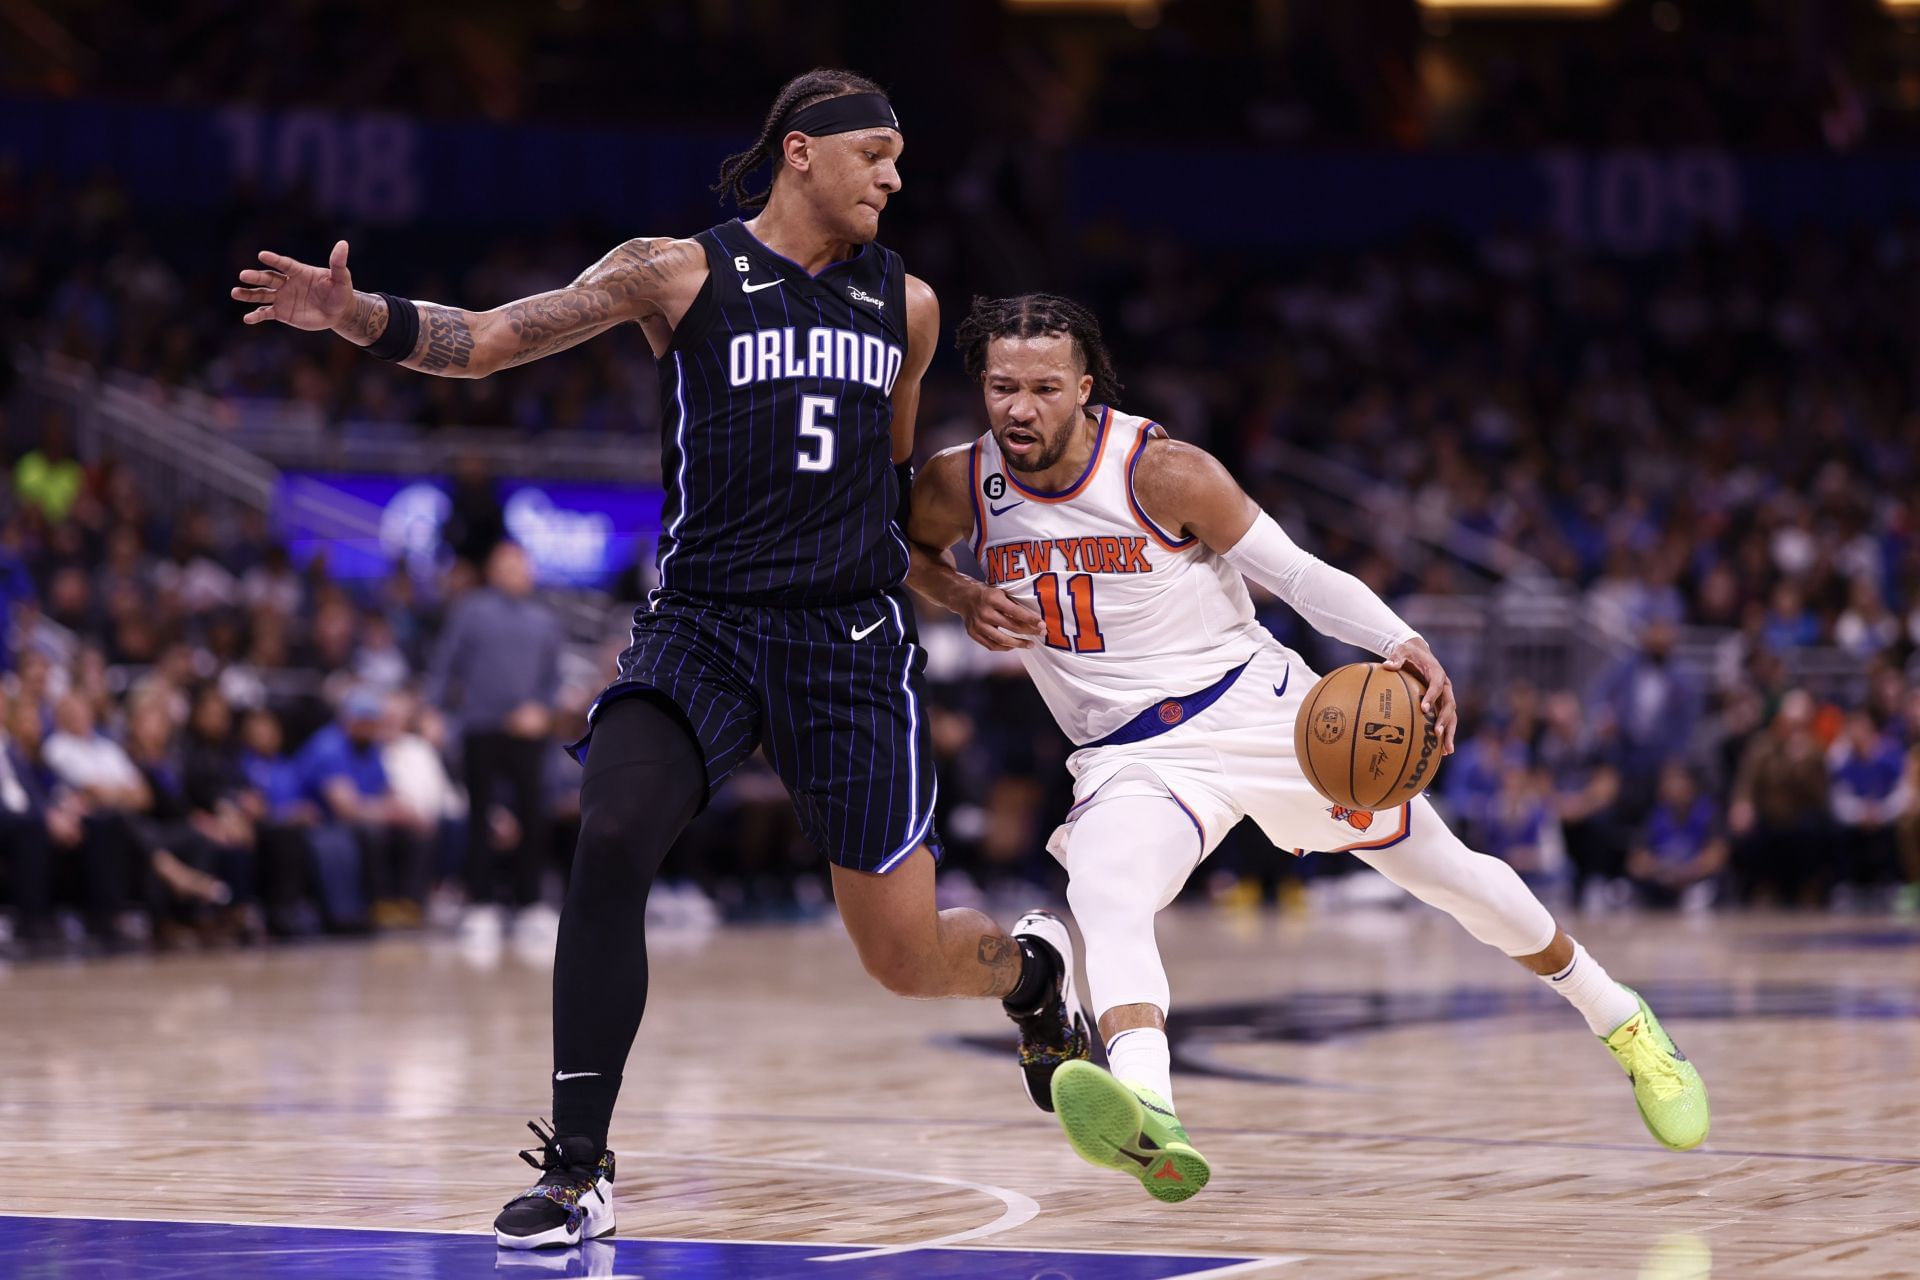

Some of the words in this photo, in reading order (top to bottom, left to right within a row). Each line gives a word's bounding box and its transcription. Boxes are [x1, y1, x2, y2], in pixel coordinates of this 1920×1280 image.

[734, 255, 750, 272] 6
[847, 285, 884, 310] Disney
[729, 326, 902, 398] ORLANDO
[797, 395, 835, 471] 5
[988, 475, 1003, 497] 6
[987, 540, 1053, 585] NEW
[1057, 537, 1152, 573] YORK
[1033, 572, 1105, 653] 11
